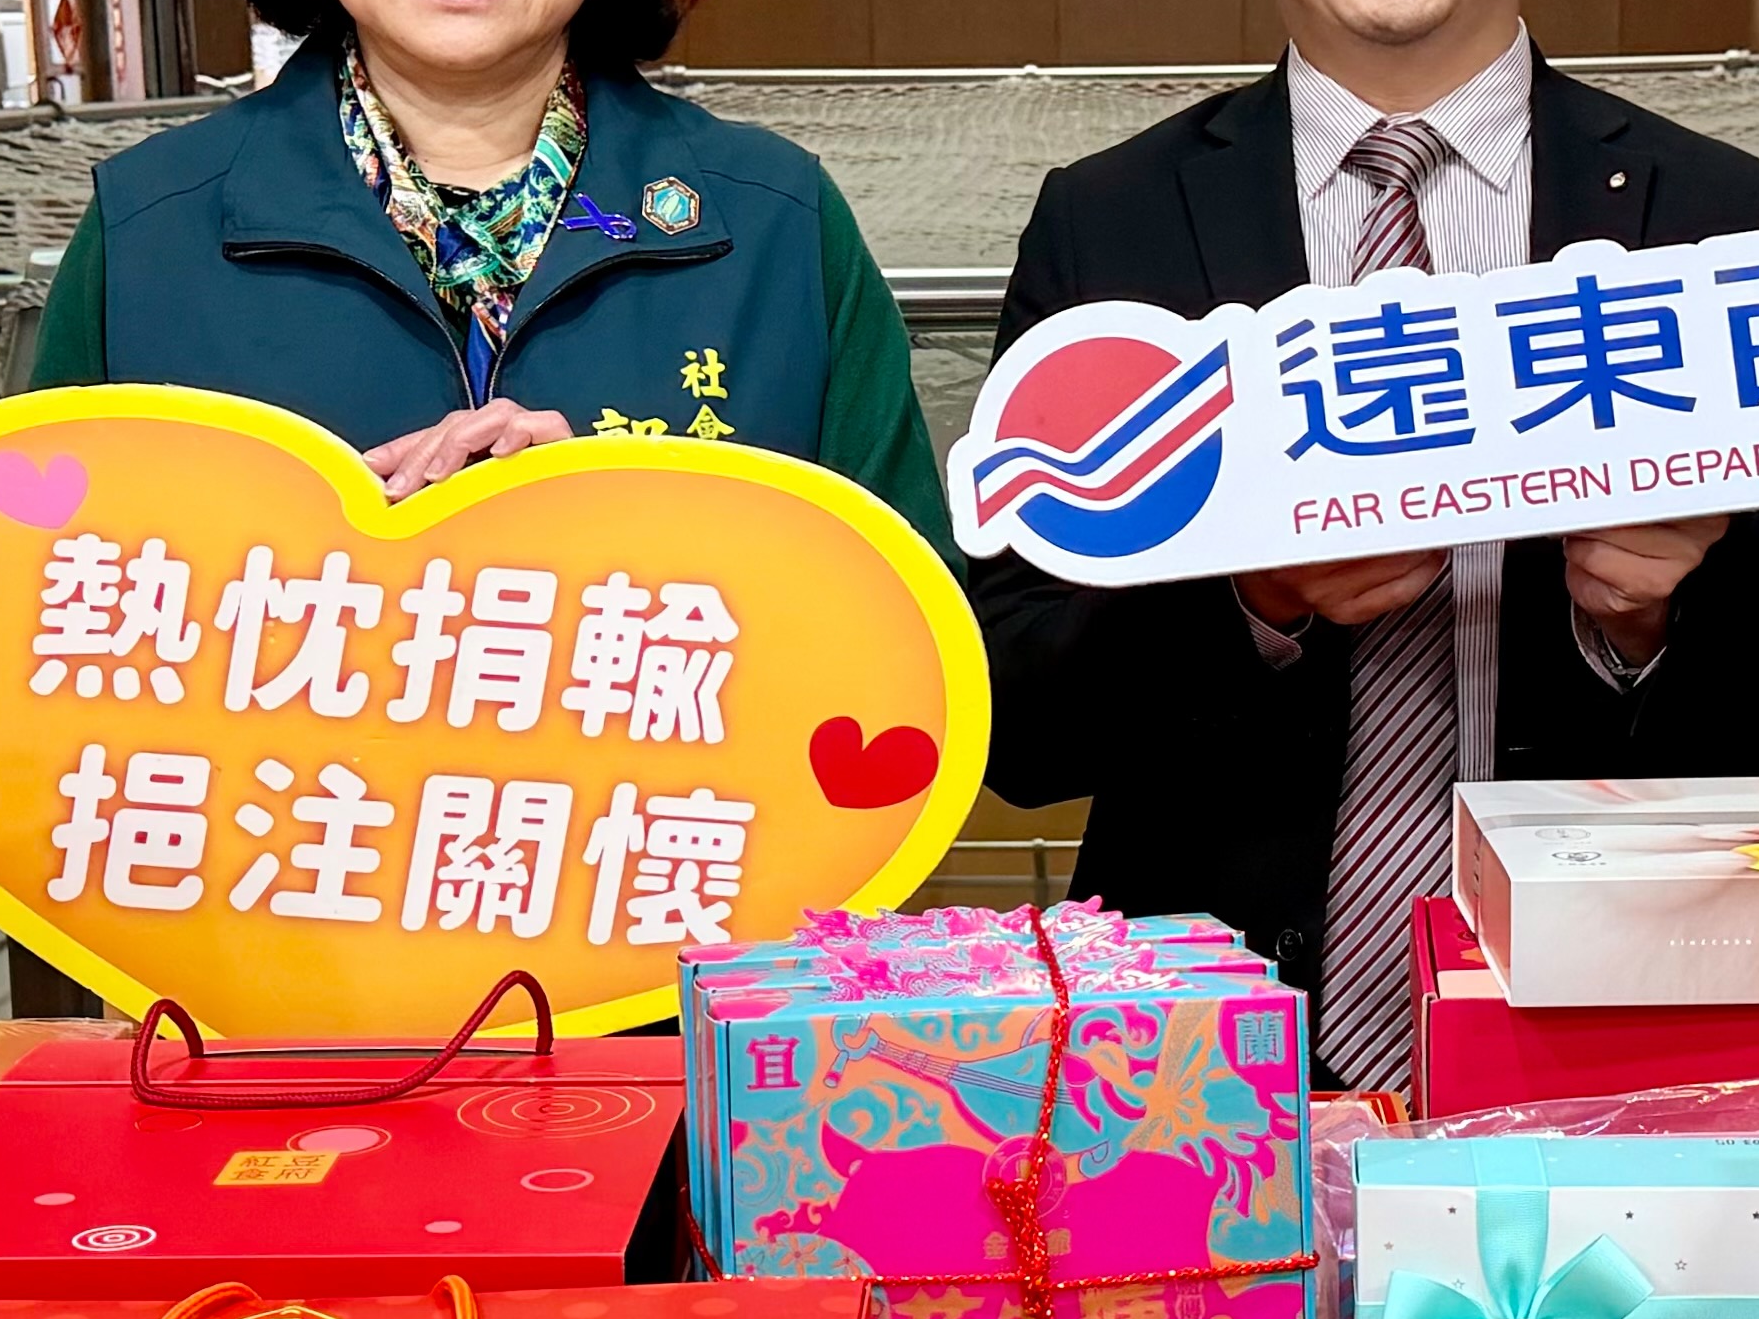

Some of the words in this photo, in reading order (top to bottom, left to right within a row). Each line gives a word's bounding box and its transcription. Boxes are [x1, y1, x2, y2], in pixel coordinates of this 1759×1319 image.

[1291, 489, 1385, 536] FAR
[1400, 461, 1612, 521] EASTERN
[28, 532, 739, 745] 熱忱捐輸
[46, 742, 759, 947] 挹注關懷
[746, 1034, 802, 1090] 宜
[1233, 1011, 1286, 1066] 蘭
